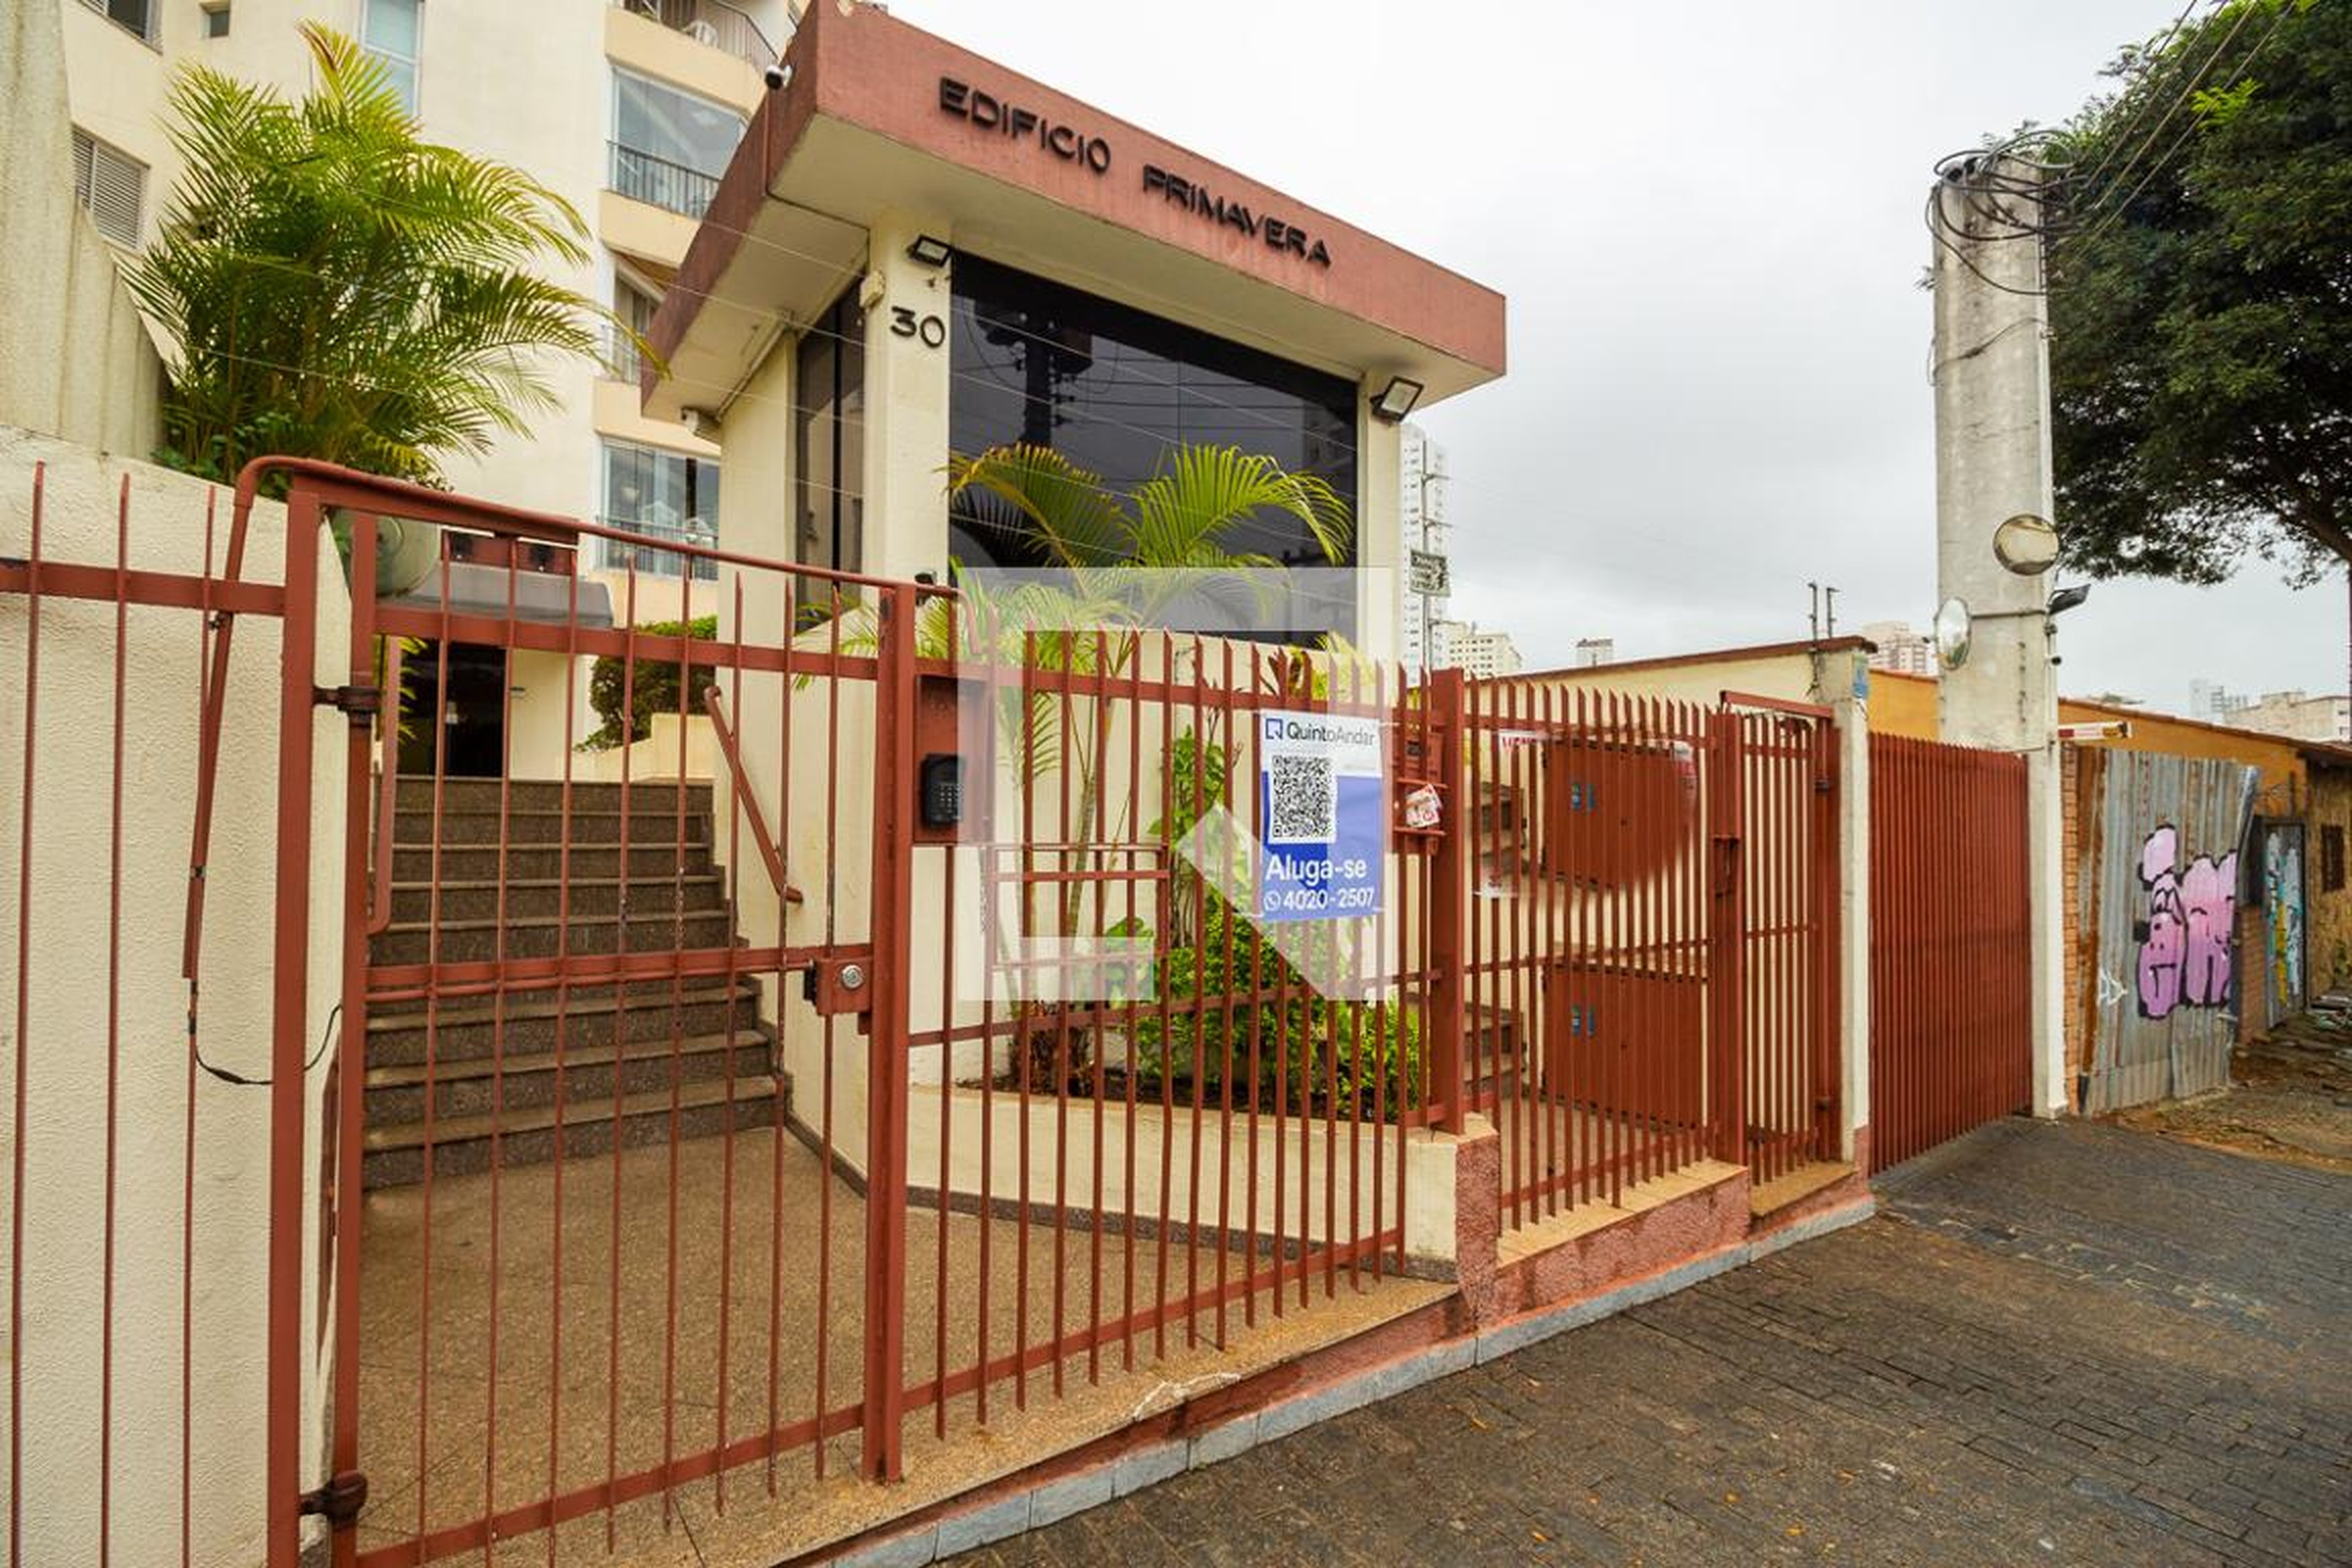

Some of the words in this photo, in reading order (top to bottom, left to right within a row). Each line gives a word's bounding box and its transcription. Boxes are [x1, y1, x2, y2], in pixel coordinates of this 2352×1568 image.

[940, 77, 1110, 173] EDIFICIO
[1143, 164, 1331, 267] PRIMAVERA
[890, 306, 946, 349] 30
[1287, 722, 1374, 745] QuintoAndar
[1265, 854, 1367, 886] Aluga-se
